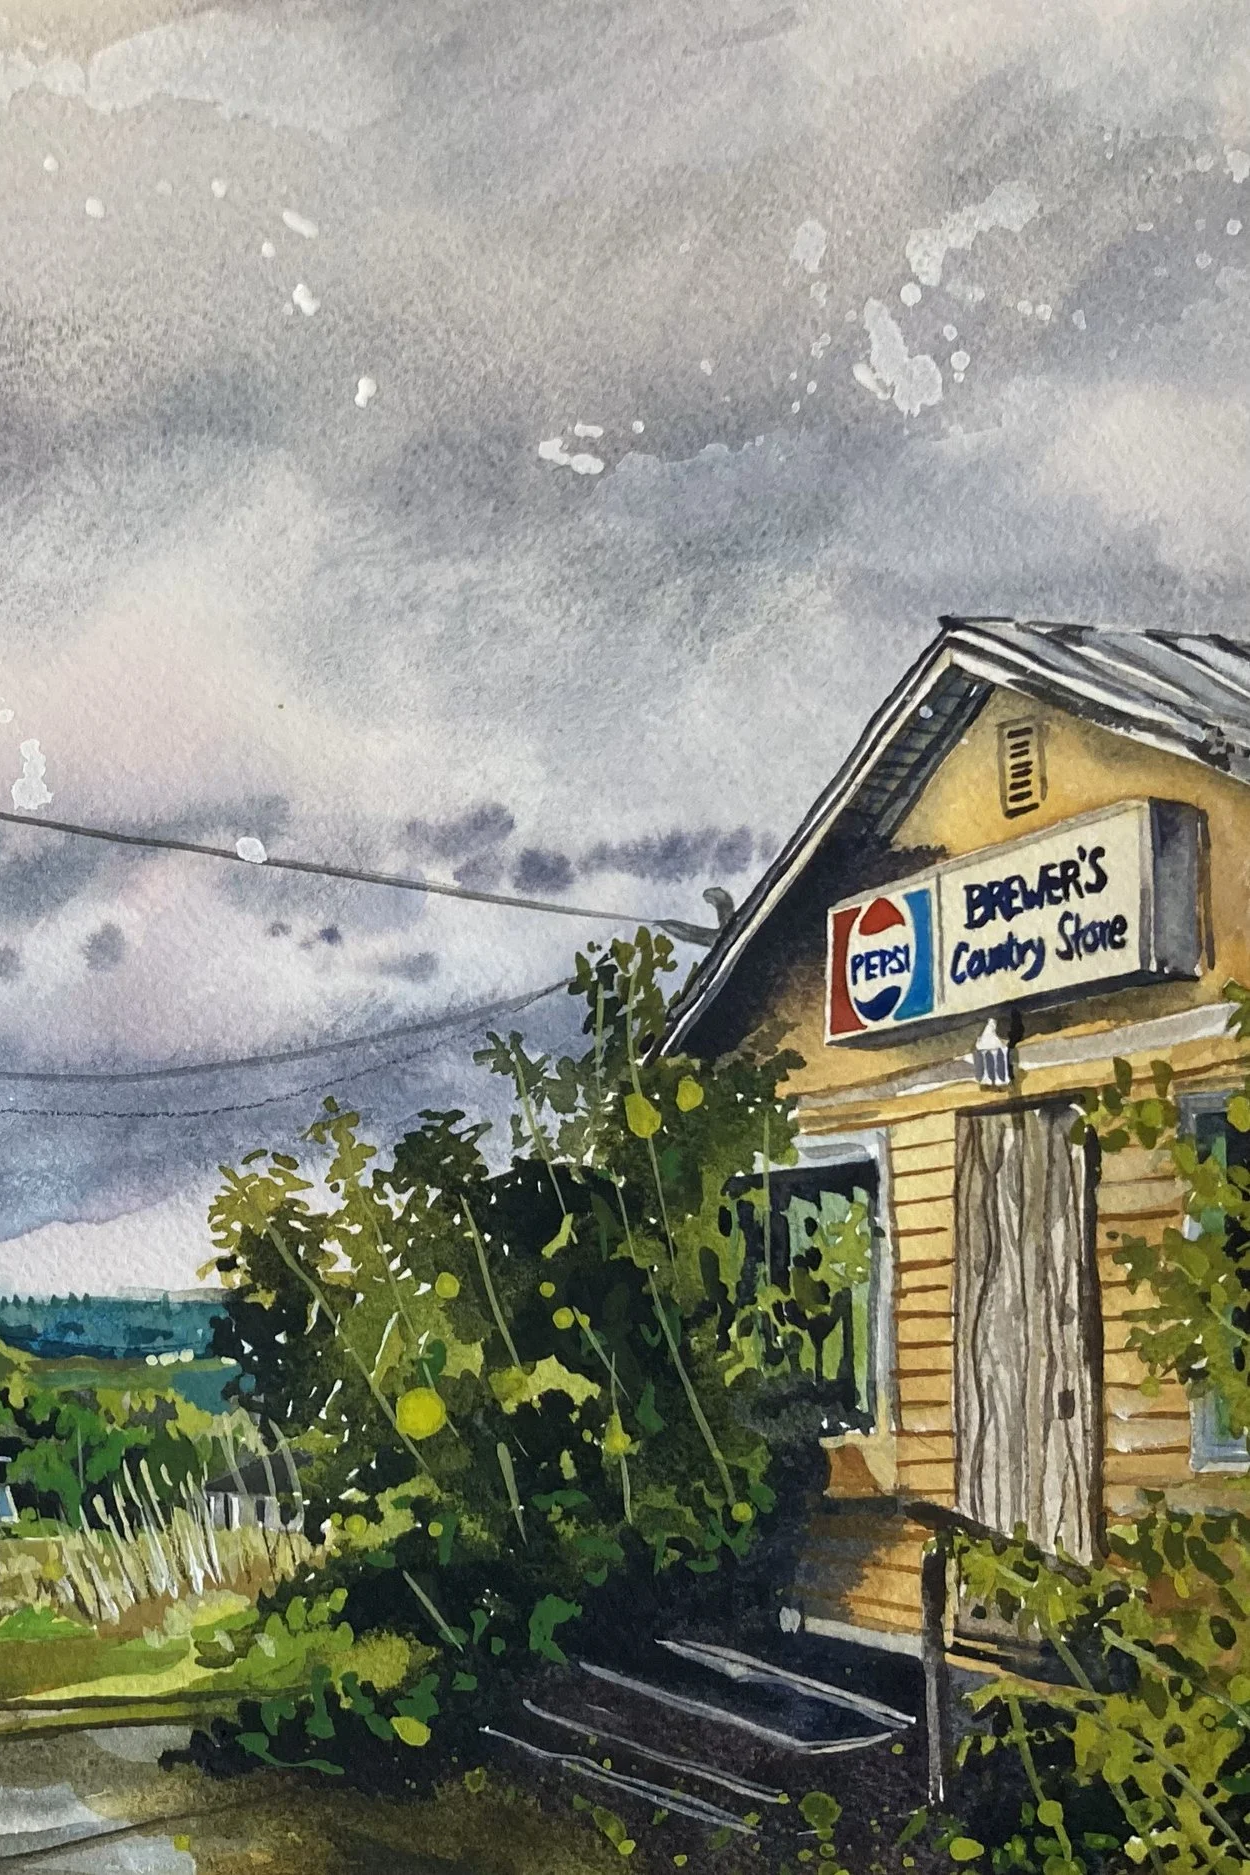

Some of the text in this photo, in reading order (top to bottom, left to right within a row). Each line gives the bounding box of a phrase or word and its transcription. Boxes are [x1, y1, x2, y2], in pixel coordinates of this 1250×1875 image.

[963, 845, 1108, 930] BREWER'S
[850, 942, 911, 986] PEPSI
[950, 910, 1128, 985] Country Store
